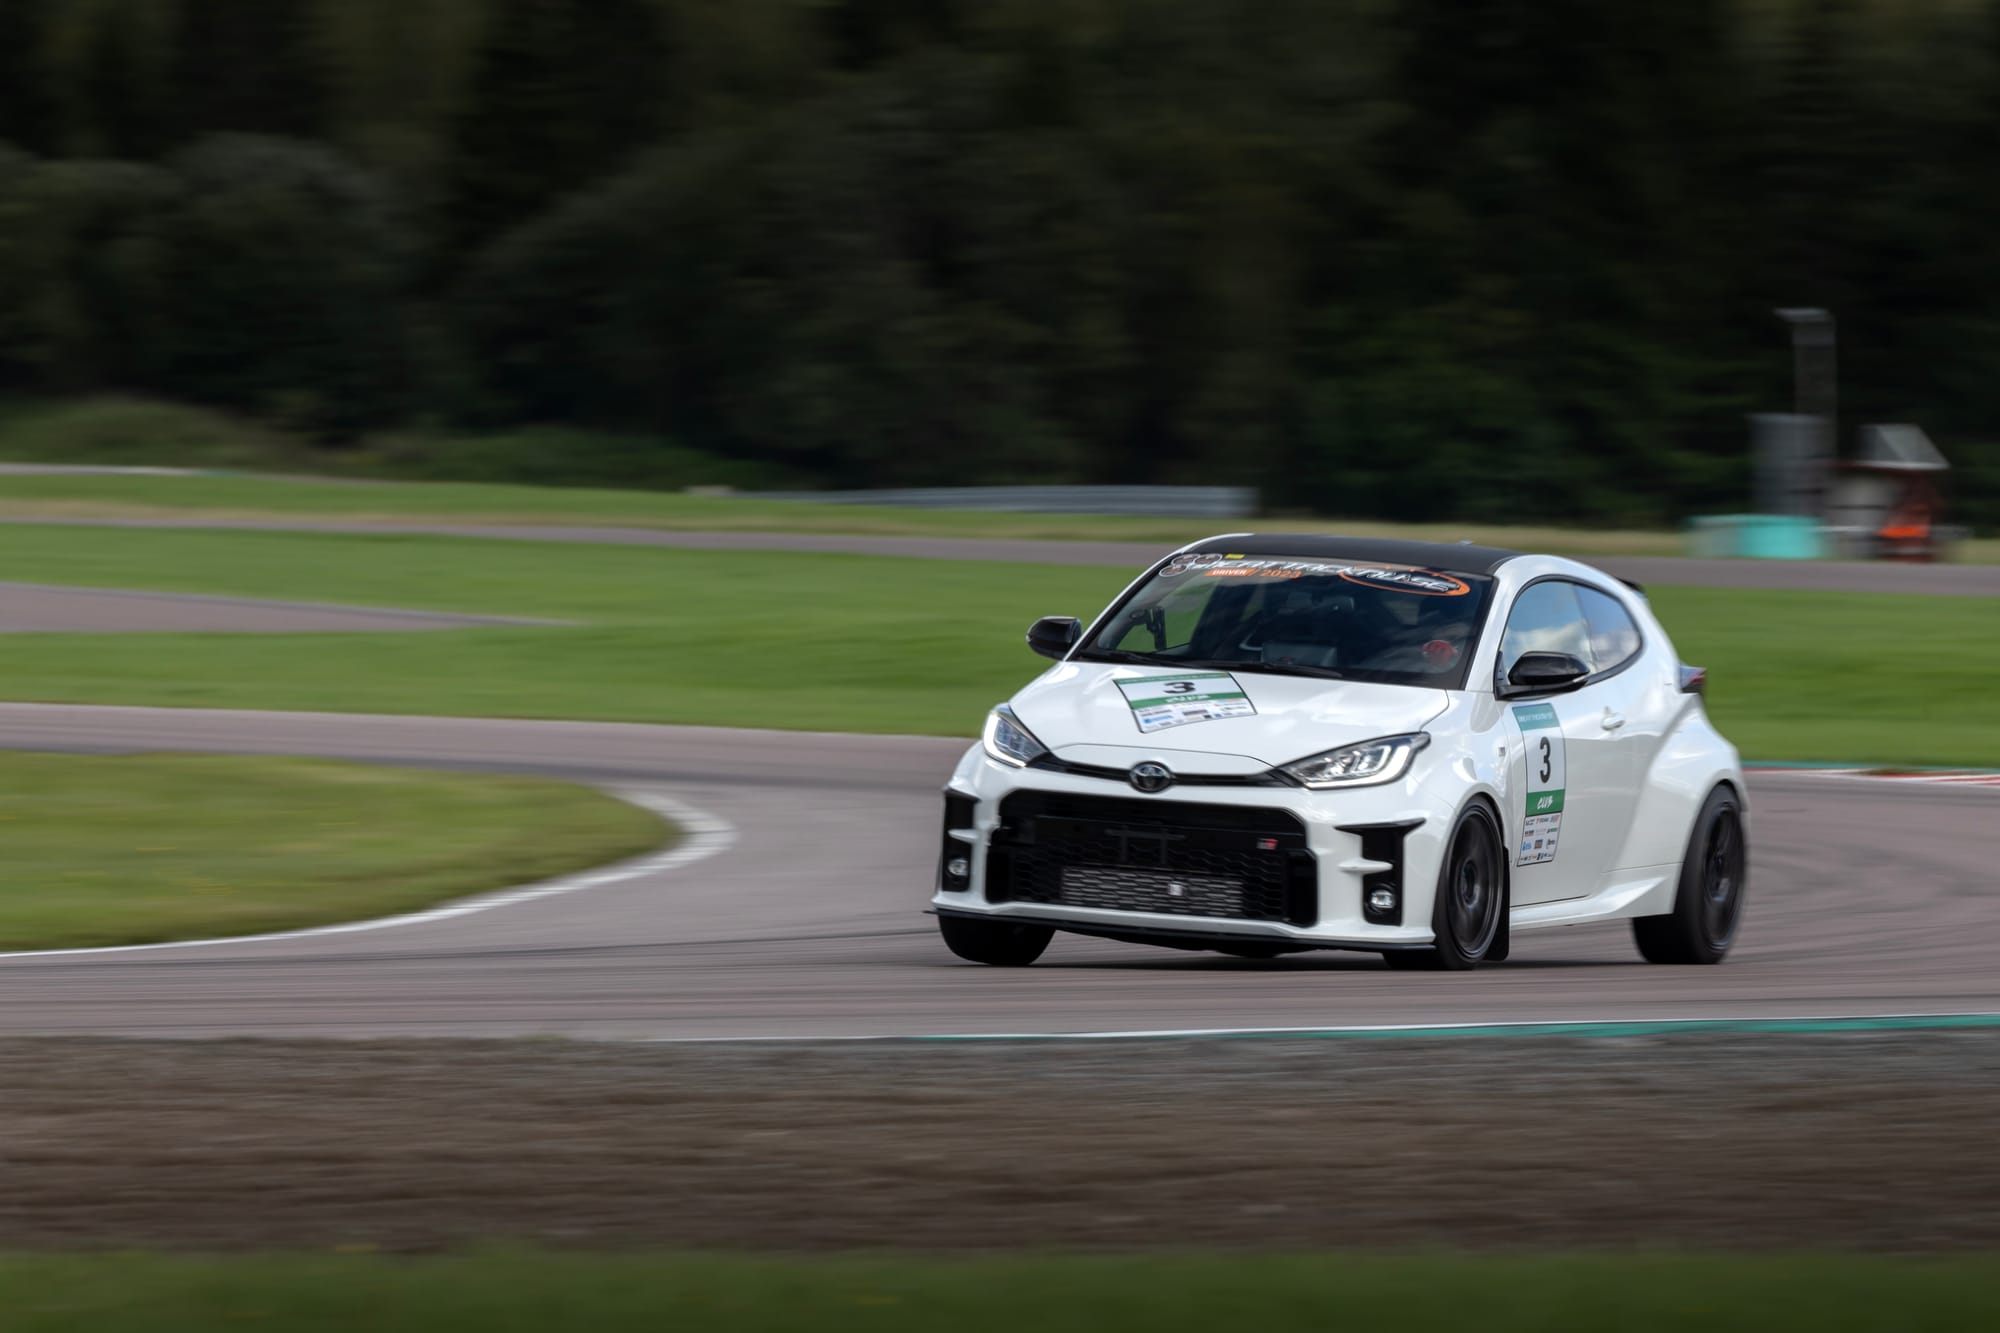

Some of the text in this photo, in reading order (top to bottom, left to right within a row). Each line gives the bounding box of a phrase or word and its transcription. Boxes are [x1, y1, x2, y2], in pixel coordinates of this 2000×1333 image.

[1211, 568, 1304, 579] DRIVER 2023
[1163, 681, 1197, 694] 3
[1539, 736, 1552, 784] 3
